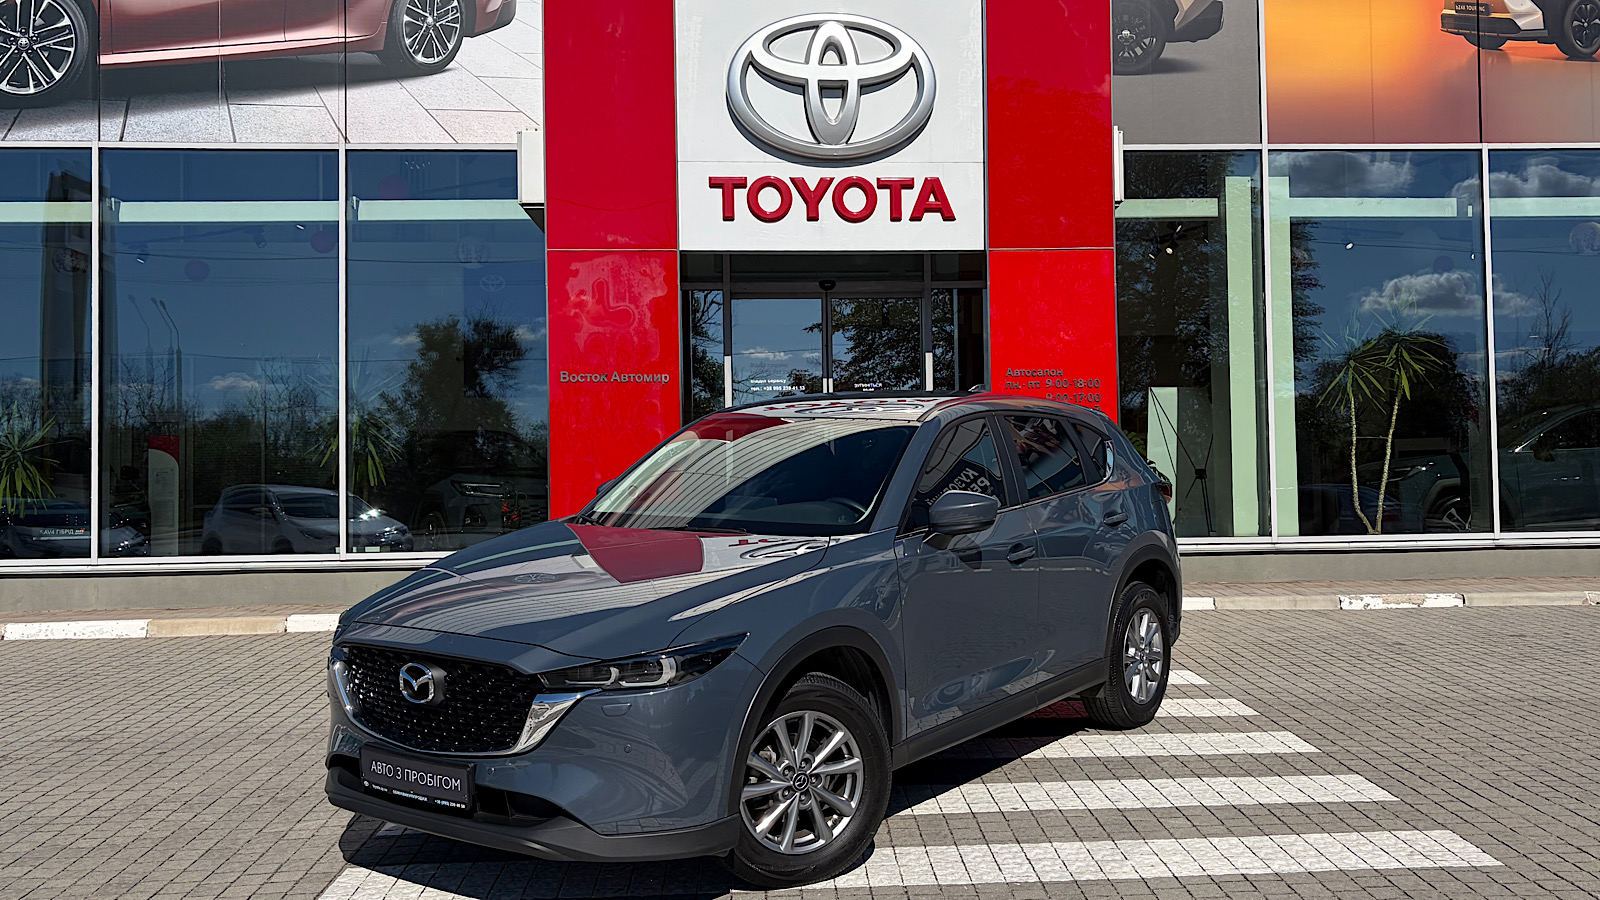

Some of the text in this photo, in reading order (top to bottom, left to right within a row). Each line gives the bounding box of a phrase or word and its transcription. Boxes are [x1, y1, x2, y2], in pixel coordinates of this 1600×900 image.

[709, 176, 957, 222] TOYOTA
[560, 371, 670, 386] Восток Автомир
[1005, 367, 1064, 377] Автосалон
[371, 761, 394, 777] АВТО
[404, 769, 461, 791] ПРОБІГОМ
